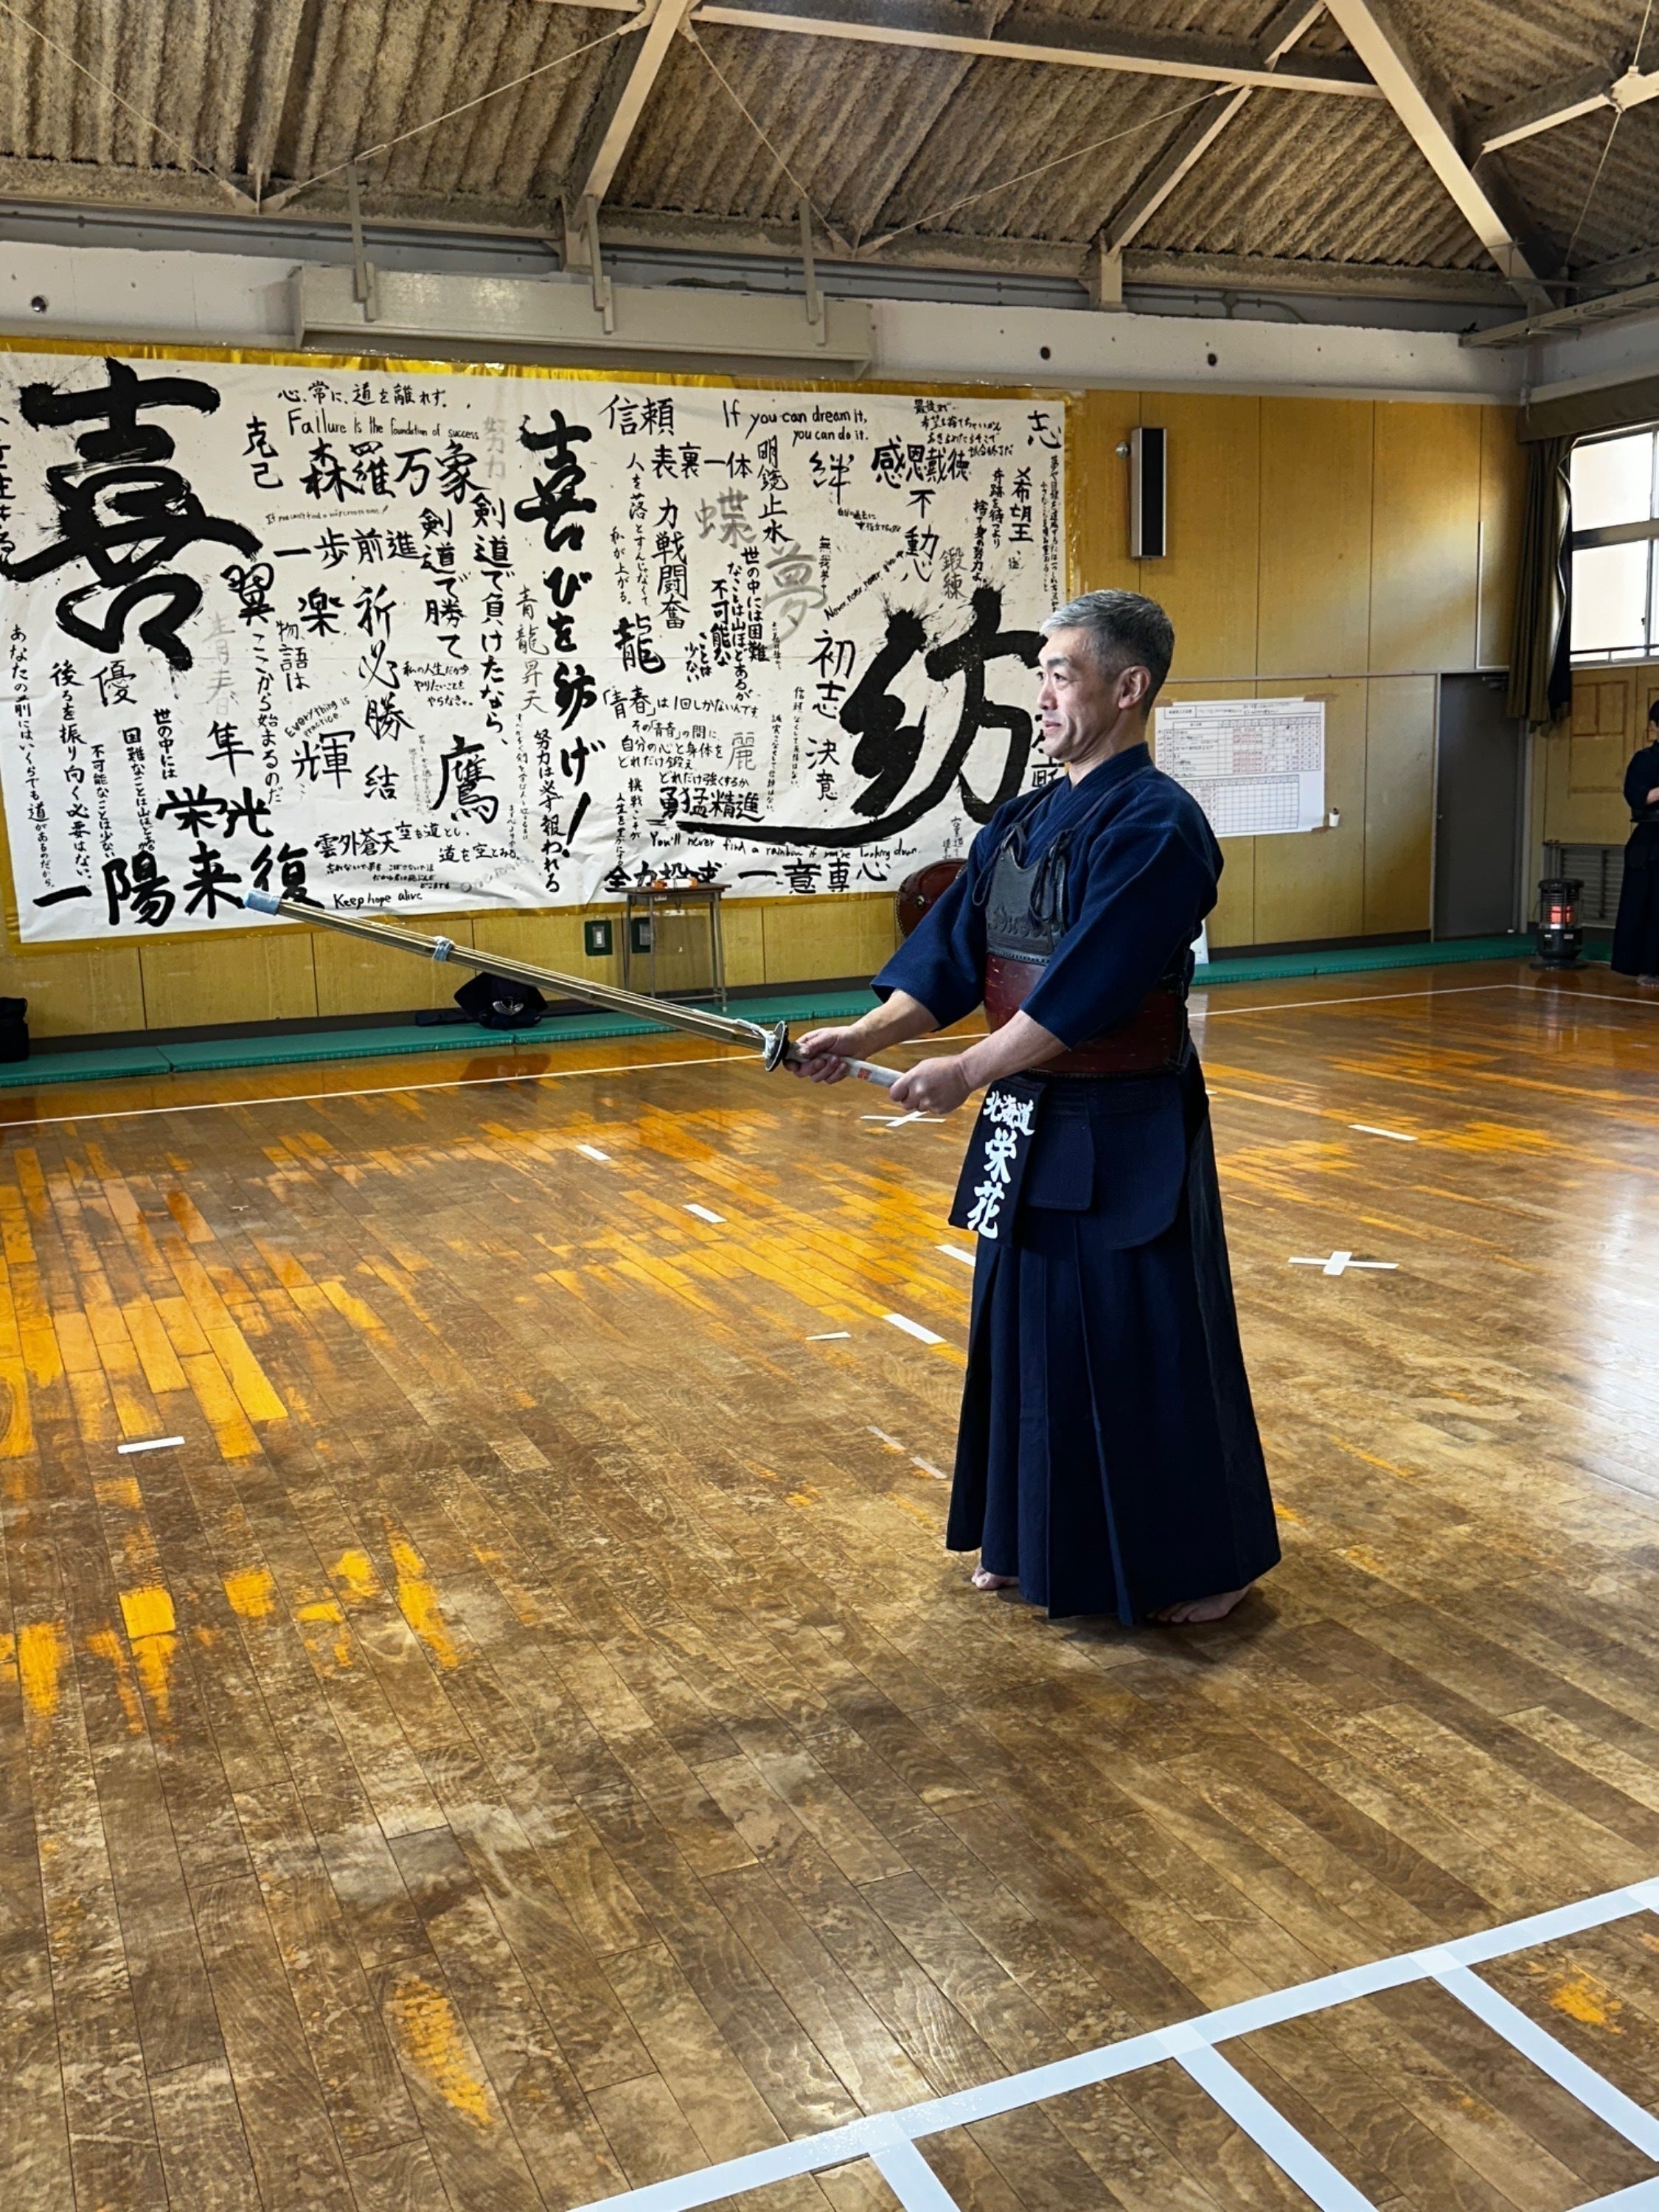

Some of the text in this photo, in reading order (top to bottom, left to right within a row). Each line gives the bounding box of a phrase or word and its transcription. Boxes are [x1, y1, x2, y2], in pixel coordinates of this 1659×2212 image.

[288, 408, 347, 437] Failure
[369, 415, 384, 435] the
[432, 422, 441, 437] of
[448, 428, 480, 440] success
[598, 394, 675, 437] 信頼
[723, 399, 868, 440] If you can dream it,
[791, 425, 869, 448] you can do it.
[1027, 410, 1062, 450] 志
[243, 411, 284, 490] 克己
[299, 437, 492, 505] 森羅万象
[651, 442, 754, 480] 表裏一体
[757, 434, 796, 544] 明鏡止水
[809, 451, 855, 506] 絆
[1008, 466, 1034, 543] 希望
[694, 486, 758, 549] 蝶
[900, 489, 941, 583] 不動心
[273, 526, 424, 570] 一歩前進
[297, 586, 345, 638] 楽
[275, 619, 310, 692] 物語は
[612, 613, 667, 675] 龍
[90, 659, 139, 708] 優
[341, 697, 350, 706] is
[152, 708, 178, 780] 世の中には
[205, 720, 255, 778] 隼
[291, 729, 355, 789] 輝
[363, 764, 400, 800] 結
[432, 734, 499, 825] 鷹
[155, 783, 275, 839] 栄光
[313, 827, 402, 858] 雲外蒼天
[650, 830, 681, 847] You'll
[687, 838, 715, 847] never
[723, 837, 746, 854] find
[808, 847, 817, 858] if
[859, 845, 891, 860] looking
[32, 840, 326, 928] 一陽来復
[333, 889, 423, 910] Keep hope alive
[737, 857, 891, 895] 一意専心
[983, 1090, 1036, 1137] 北海道
[967, 1127, 1018, 1239] 栄花
